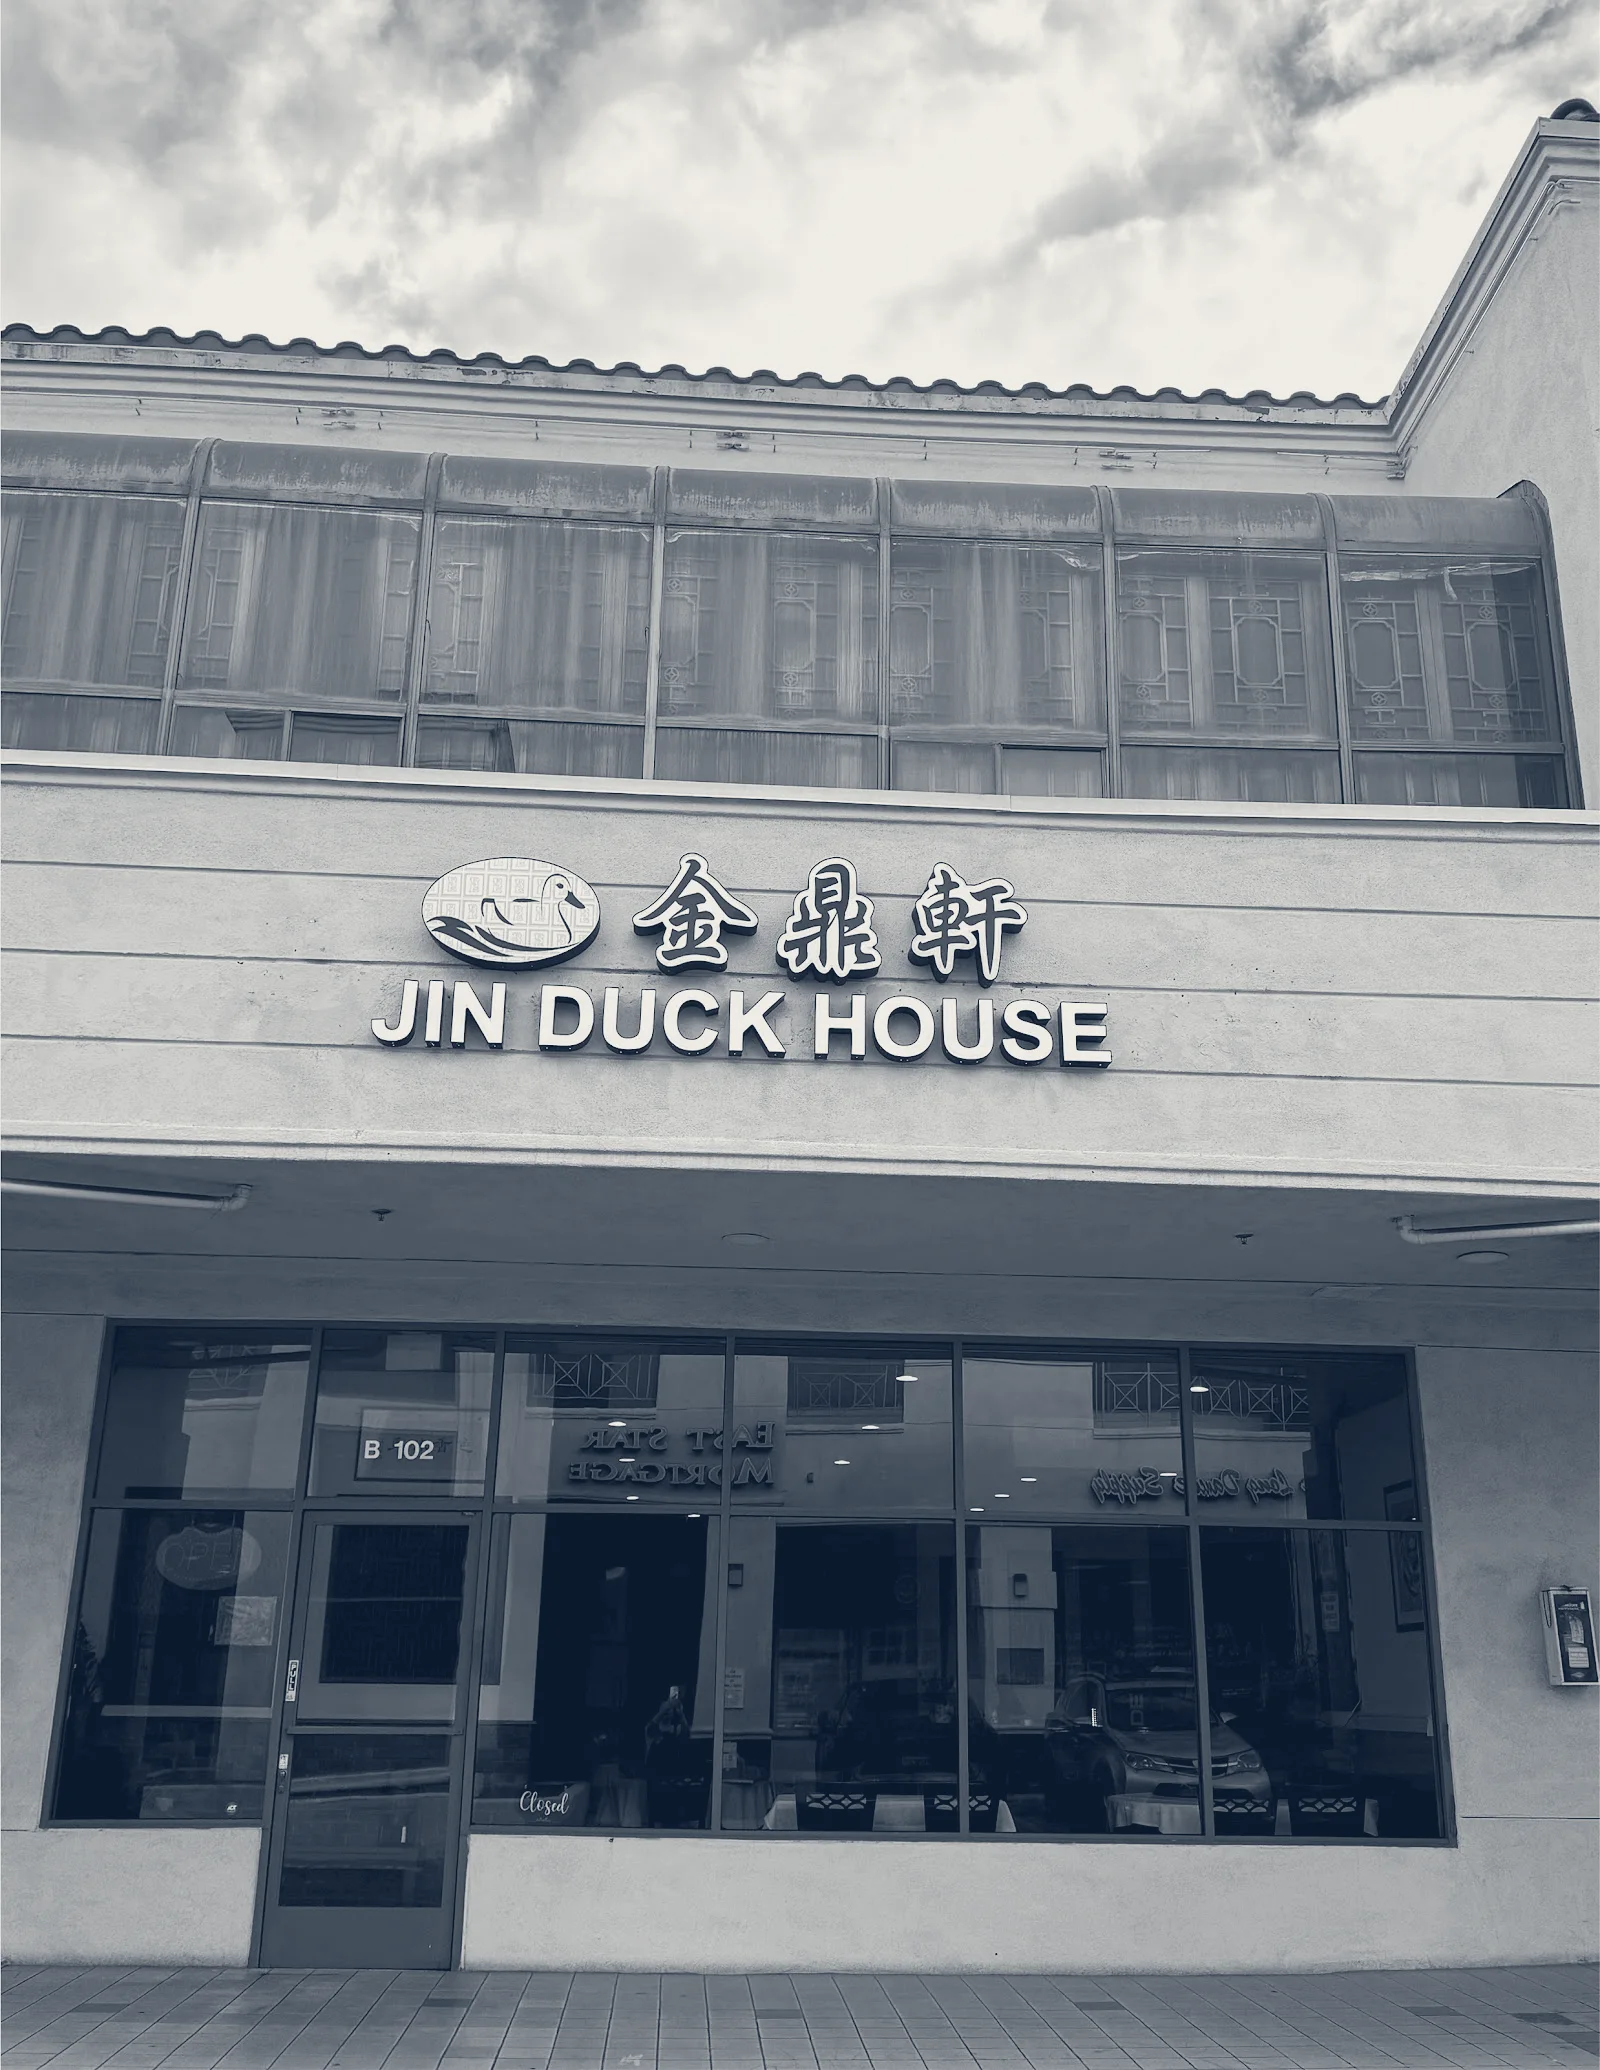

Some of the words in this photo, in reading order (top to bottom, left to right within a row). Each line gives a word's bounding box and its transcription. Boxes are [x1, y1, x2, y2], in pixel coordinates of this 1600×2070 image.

[634, 853, 1028, 986] 金鼎軒
[371, 979, 507, 1048] JIN
[538, 984, 787, 1059] DUCK
[814, 993, 1113, 1068] HOUSE
[364, 1440, 381, 1459] B
[394, 1440, 435, 1460] 102
[288, 1662, 298, 1691] PULL
[519, 1790, 570, 1816] Closed
